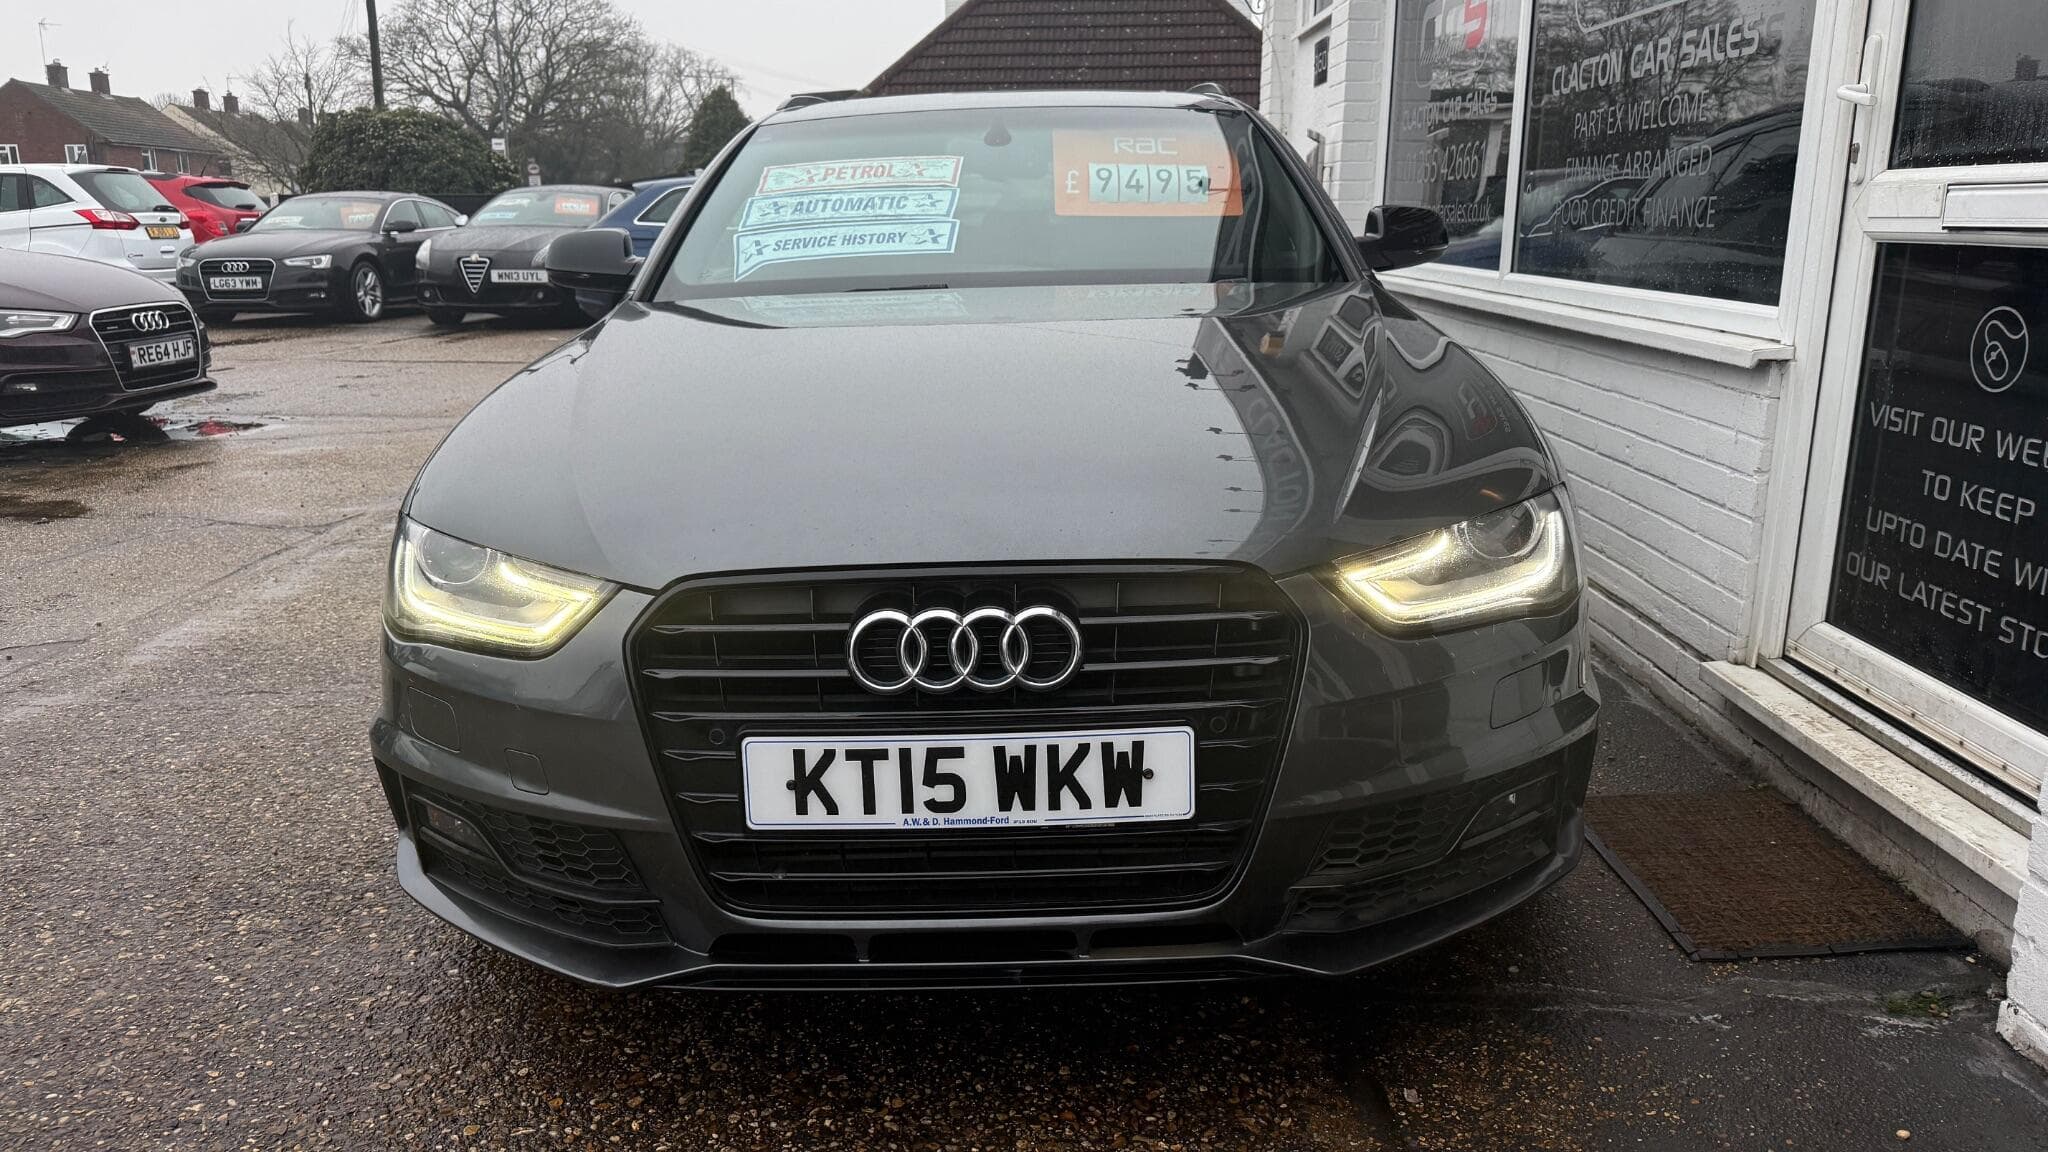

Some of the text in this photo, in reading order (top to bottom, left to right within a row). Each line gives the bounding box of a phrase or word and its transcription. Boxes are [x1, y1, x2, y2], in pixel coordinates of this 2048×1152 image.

[1552, 17, 1760, 96] CLACTON CAR SALES
[1442, 96, 1463, 123] CAR
[1465, 88, 1498, 119] SALES
[1574, 89, 1710, 139] PART EX WELCOME
[819, 164, 895, 182] PETROL
[1441, 140, 1487, 181] 426661
[1565, 144, 1713, 182] FINANCE ARRANGED
[1095, 167, 1204, 194] 9495
[790, 195, 909, 216] AUTOMATIC
[1554, 195, 1718, 228] POOR CREDIT FINANCE
[772, 231, 908, 252] SERVICE HISTORY
[497, 271, 542, 281] WN13 UYL
[137, 339, 192, 365] RE64 HJF
[1870, 401, 1924, 437] VISIT
[1930, 416, 1985, 453] OUR
[1922, 469, 2036, 524] TO KEEP
[1866, 506, 1926, 549] UPTO
[1934, 530, 2003, 579] DATE
[1846, 551, 1891, 590] OUR
[1898, 572, 1992, 632] LATEST
[792, 740, 1145, 816] KT15 WKW
[943, 816, 1010, 826] Hammond-Ford
